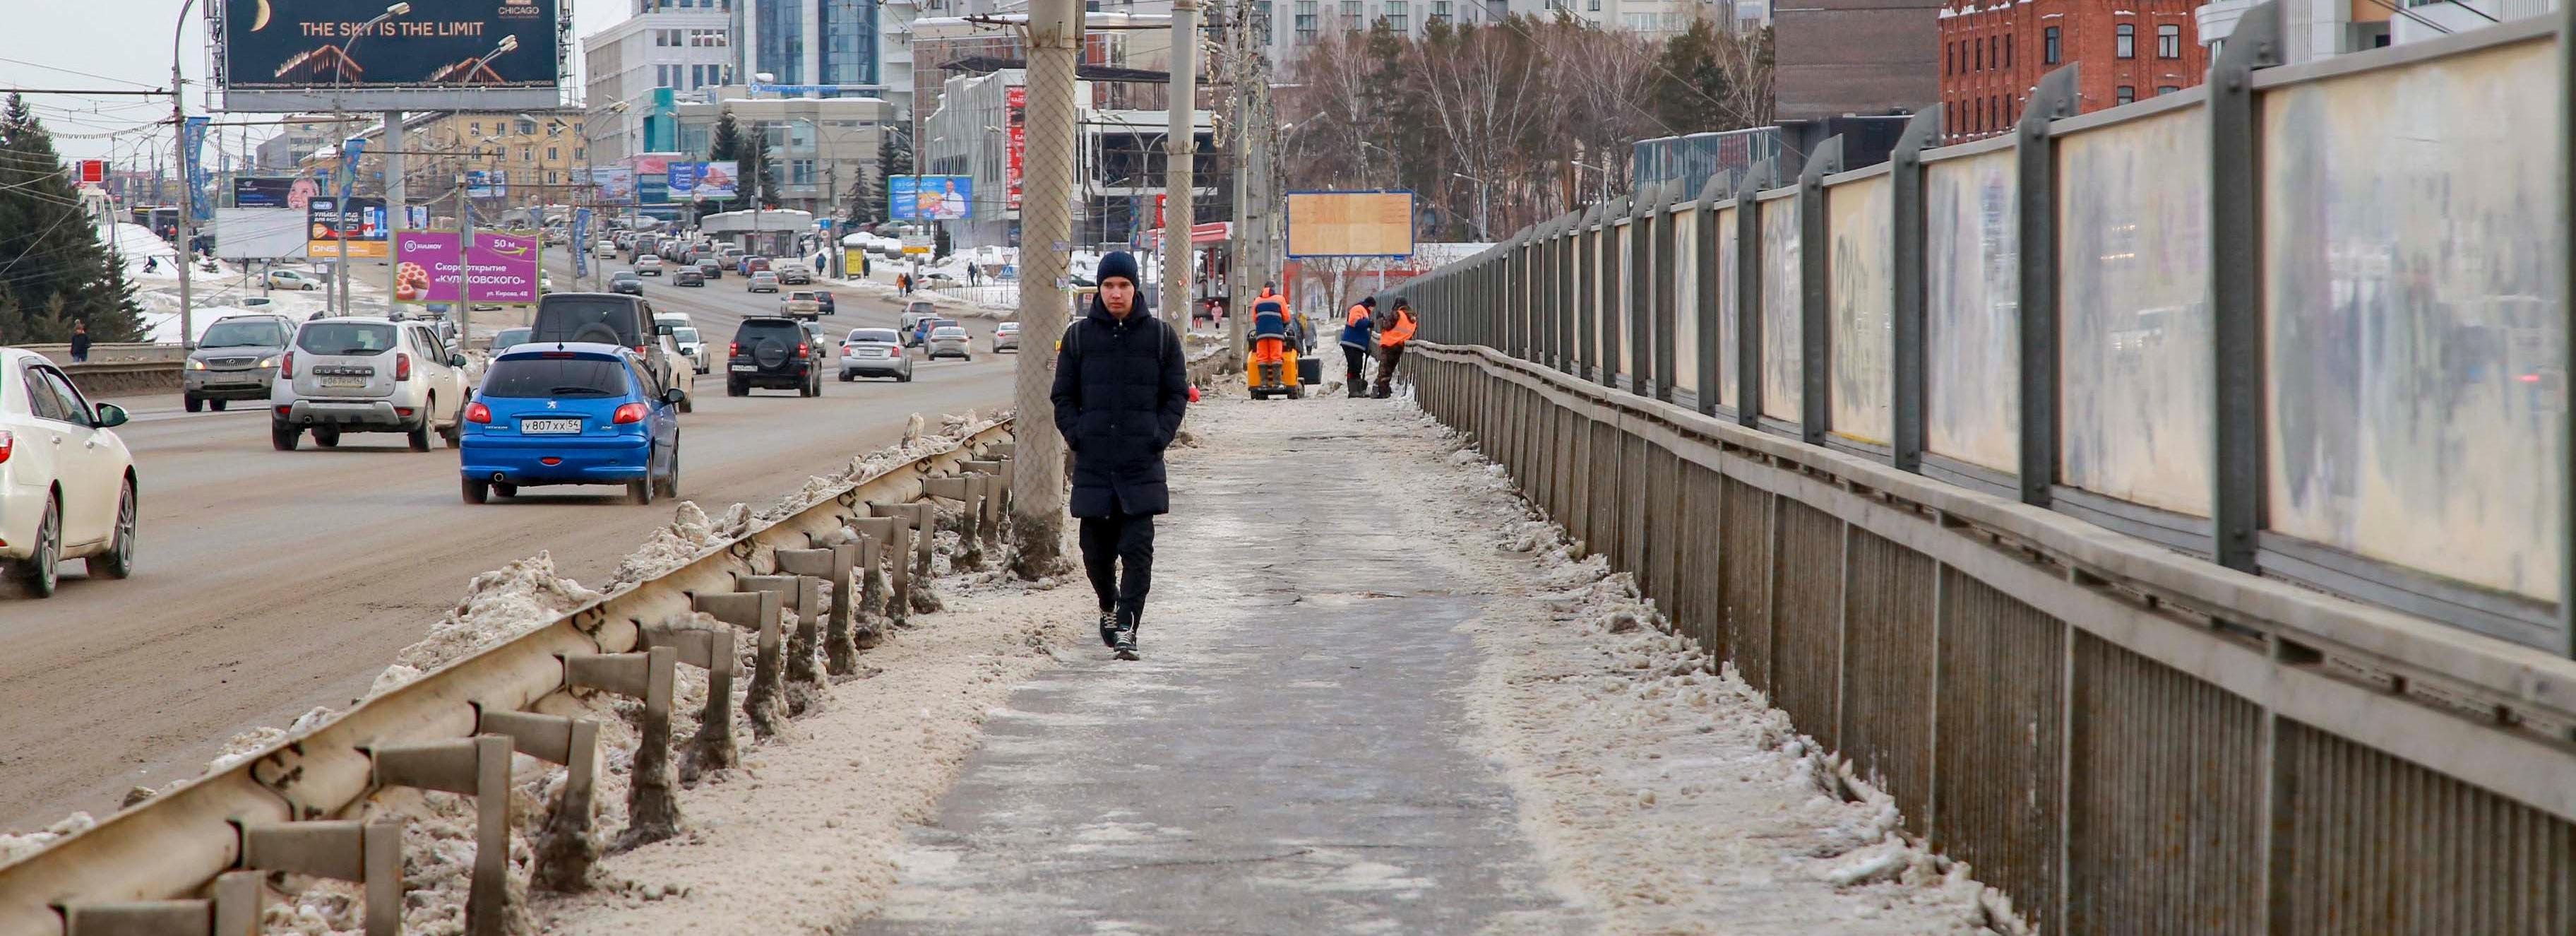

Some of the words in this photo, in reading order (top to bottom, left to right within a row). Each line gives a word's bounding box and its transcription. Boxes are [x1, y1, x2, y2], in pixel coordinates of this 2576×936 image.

[299, 22, 335, 36] THE
[340, 22, 373, 36] SKY
[380, 22, 395, 35] IS
[400, 22, 434, 35] THE
[439, 22, 484, 35] LIMIT
[466, 265, 506, 273] открытие
